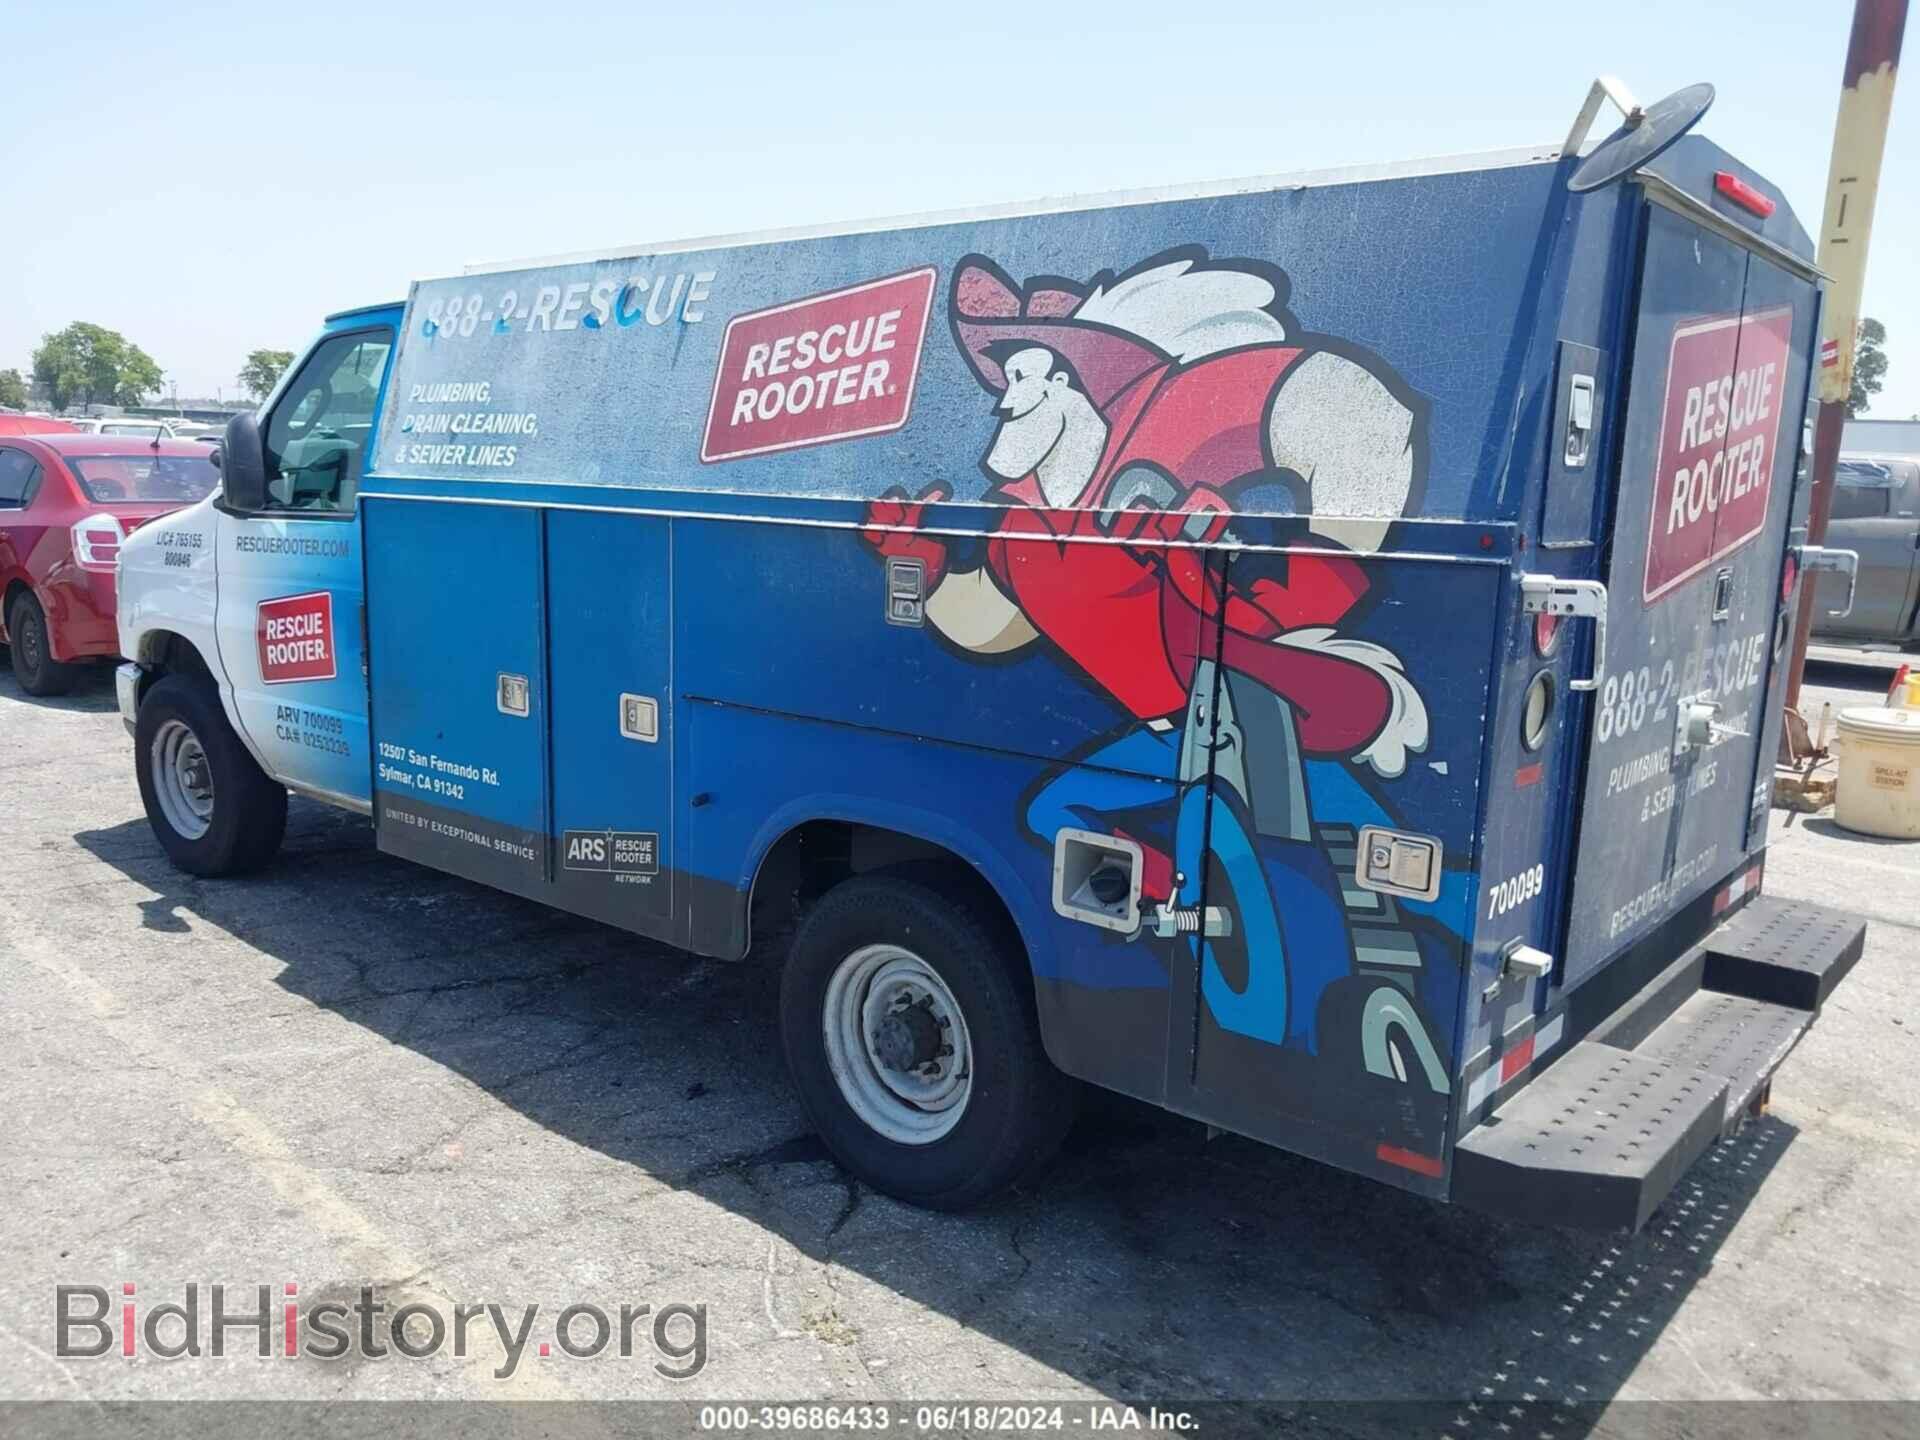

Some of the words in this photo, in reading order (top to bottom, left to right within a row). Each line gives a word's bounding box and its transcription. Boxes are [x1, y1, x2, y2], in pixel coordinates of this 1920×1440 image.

[421, 271, 717, 338] 888-2-RESCUE
[742, 309, 902, 382] RESCUE
[408, 381, 491, 405] PLUMBING,
[1679, 361, 1776, 453] RESCUE
[401, 413, 450, 433] DRAIN
[450, 412, 538, 438] CLEANING,
[395, 445, 407, 463] &
[409, 444, 466, 465] SEWER
[466, 446, 517, 466] LINES
[235, 535, 350, 558] RESCUEROOTER.COM
[266, 612, 323, 641] RESCUE
[276, 724, 300, 743] CA#
[277, 705, 300, 724] ARV
[303, 711, 343, 735] 700099
[379, 742, 406, 760] 12507
[408, 749, 428, 769] San
[430, 755, 480, 780] Fernando
[482, 768, 500, 786] Rd.
[379, 763, 415, 788] Sylmar,
[417, 774, 432, 791] CA
[434, 779, 464, 800] 91342
[385, 808, 415, 825] UNITED
[417, 816, 429, 829] BY
[431, 821, 491, 848] EXCEPTIONAL
[494, 839, 535, 860] SERVICE
[615, 839, 652, 852] RESCUE
[567, 838, 605, 861] ARS
[614, 851, 652, 864] ROOTER
[615, 874, 651, 884] NETWORK
[1488, 863, 1544, 920] 700099
